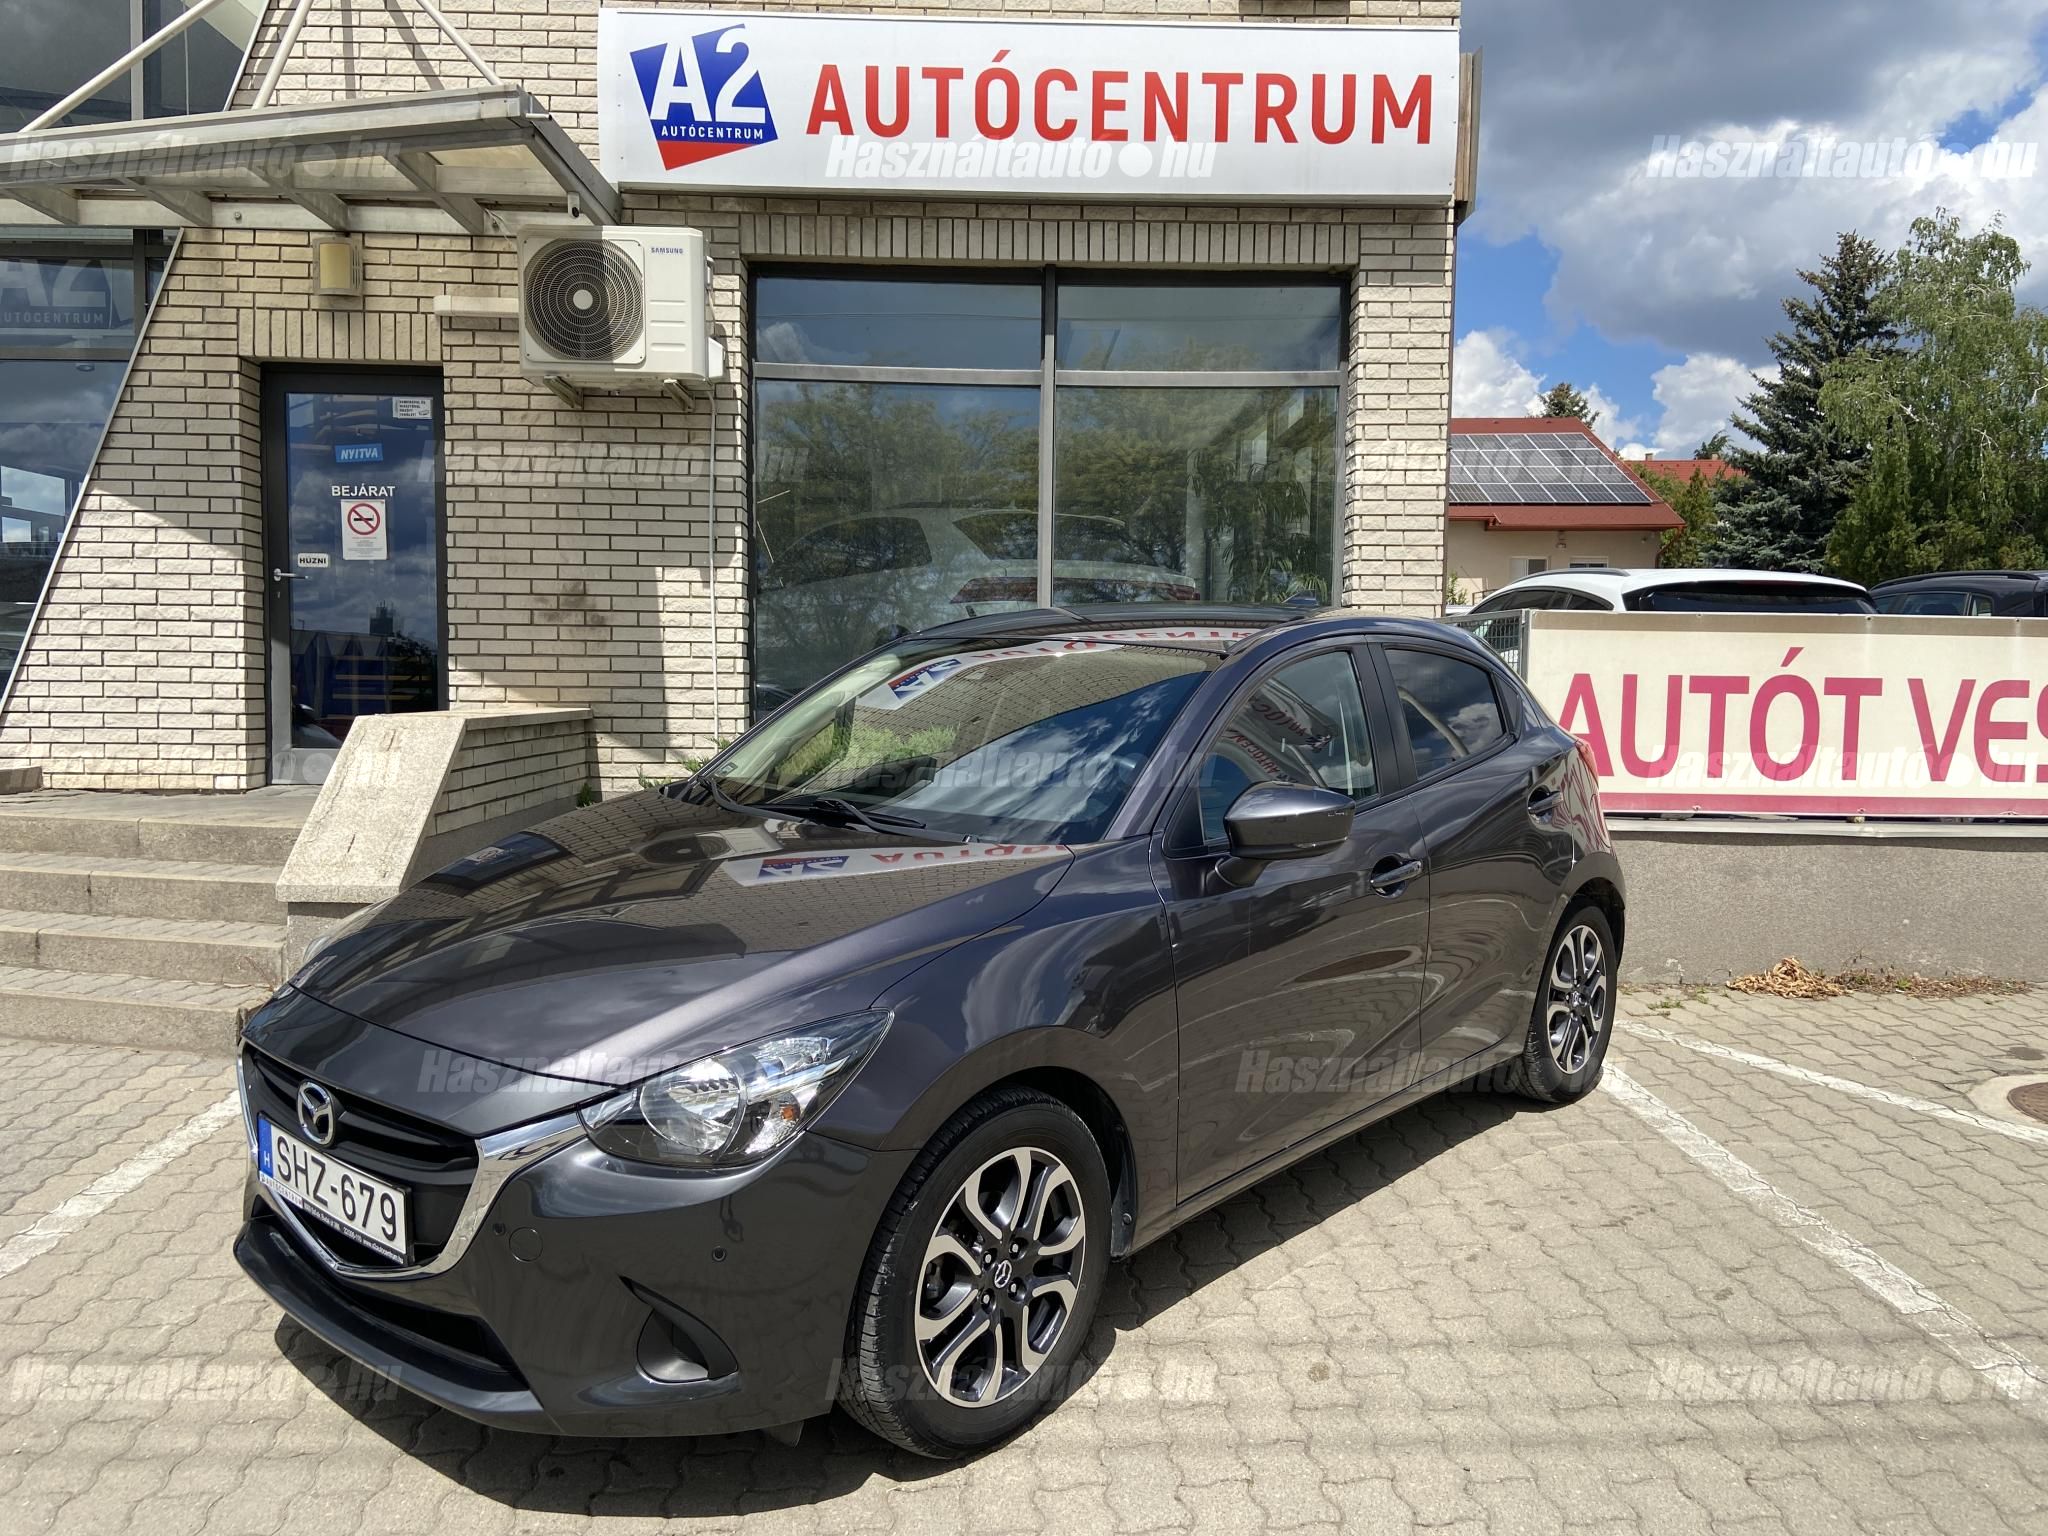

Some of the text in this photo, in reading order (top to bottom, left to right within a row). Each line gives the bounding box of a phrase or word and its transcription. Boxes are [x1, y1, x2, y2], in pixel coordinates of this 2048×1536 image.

[649, 27, 766, 124] A2
[805, 49, 1432, 145] AUTÓCENTRUM
[661, 123, 763, 140] AUTÓCENTRUM
[651, 246, 684, 255] SAMSUNG
[2, 309, 104, 325] UTÓCENTRUM
[341, 447, 379, 460] NYITVA
[331, 482, 396, 497] BEJÁRAT
[1557, 645, 2048, 784] AUTÓT VE
[263, 1150, 271, 1169] H
[276, 1135, 397, 1242] SHZ-679
